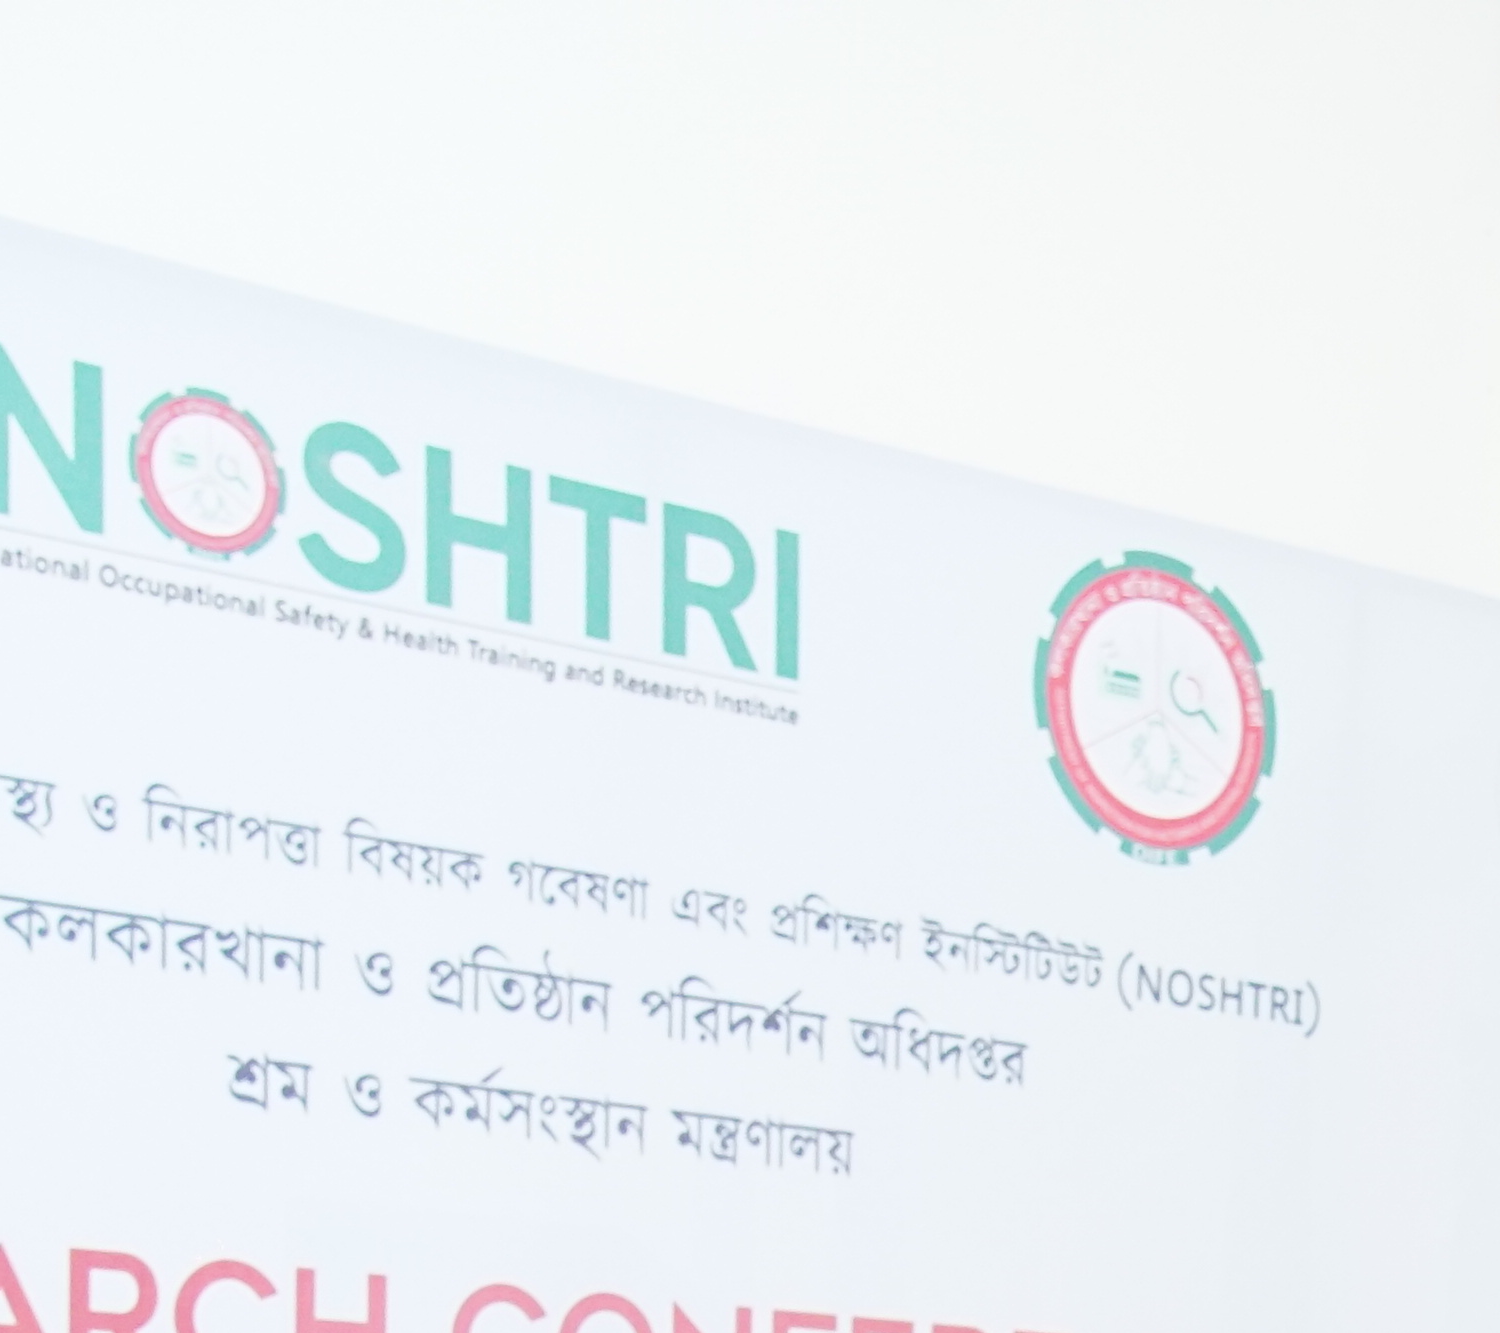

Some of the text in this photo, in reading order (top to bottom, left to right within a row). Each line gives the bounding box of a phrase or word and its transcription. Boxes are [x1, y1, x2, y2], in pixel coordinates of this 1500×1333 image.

[98, 563, 266, 617] Occupational
[274, 599, 349, 640] Safety
[357, 617, 374, 639] &
[382, 621, 459, 658] Health
[465, 638, 556, 683] Training
[565, 659, 605, 688] and
[613, 667, 706, 710] Research
[713, 690, 800, 727] Institute
[86, 791, 119, 834] ও
[141, 783, 321, 869] নিরাপত্তা
[344, 817, 484, 888] বিষয়ক
[508, 857, 649, 921] গবেষণা
[672, 888, 748, 937] এবং
[770, 893, 902, 961] প্রশিক্ষণ
[1116, 950, 1323, 1038] (NOSHTRI)
[354, 951, 393, 996] ও
[427, 944, 613, 1034] প্রতিষ্ঠান
[640, 975, 828, 1062] পরিদর্শন
[849, 1008, 1029, 1087] অধিদপ্তর
[227, 1053, 855, 1178] শ্রম ও কর্মসংস্থান মন্ত্রণালয়
